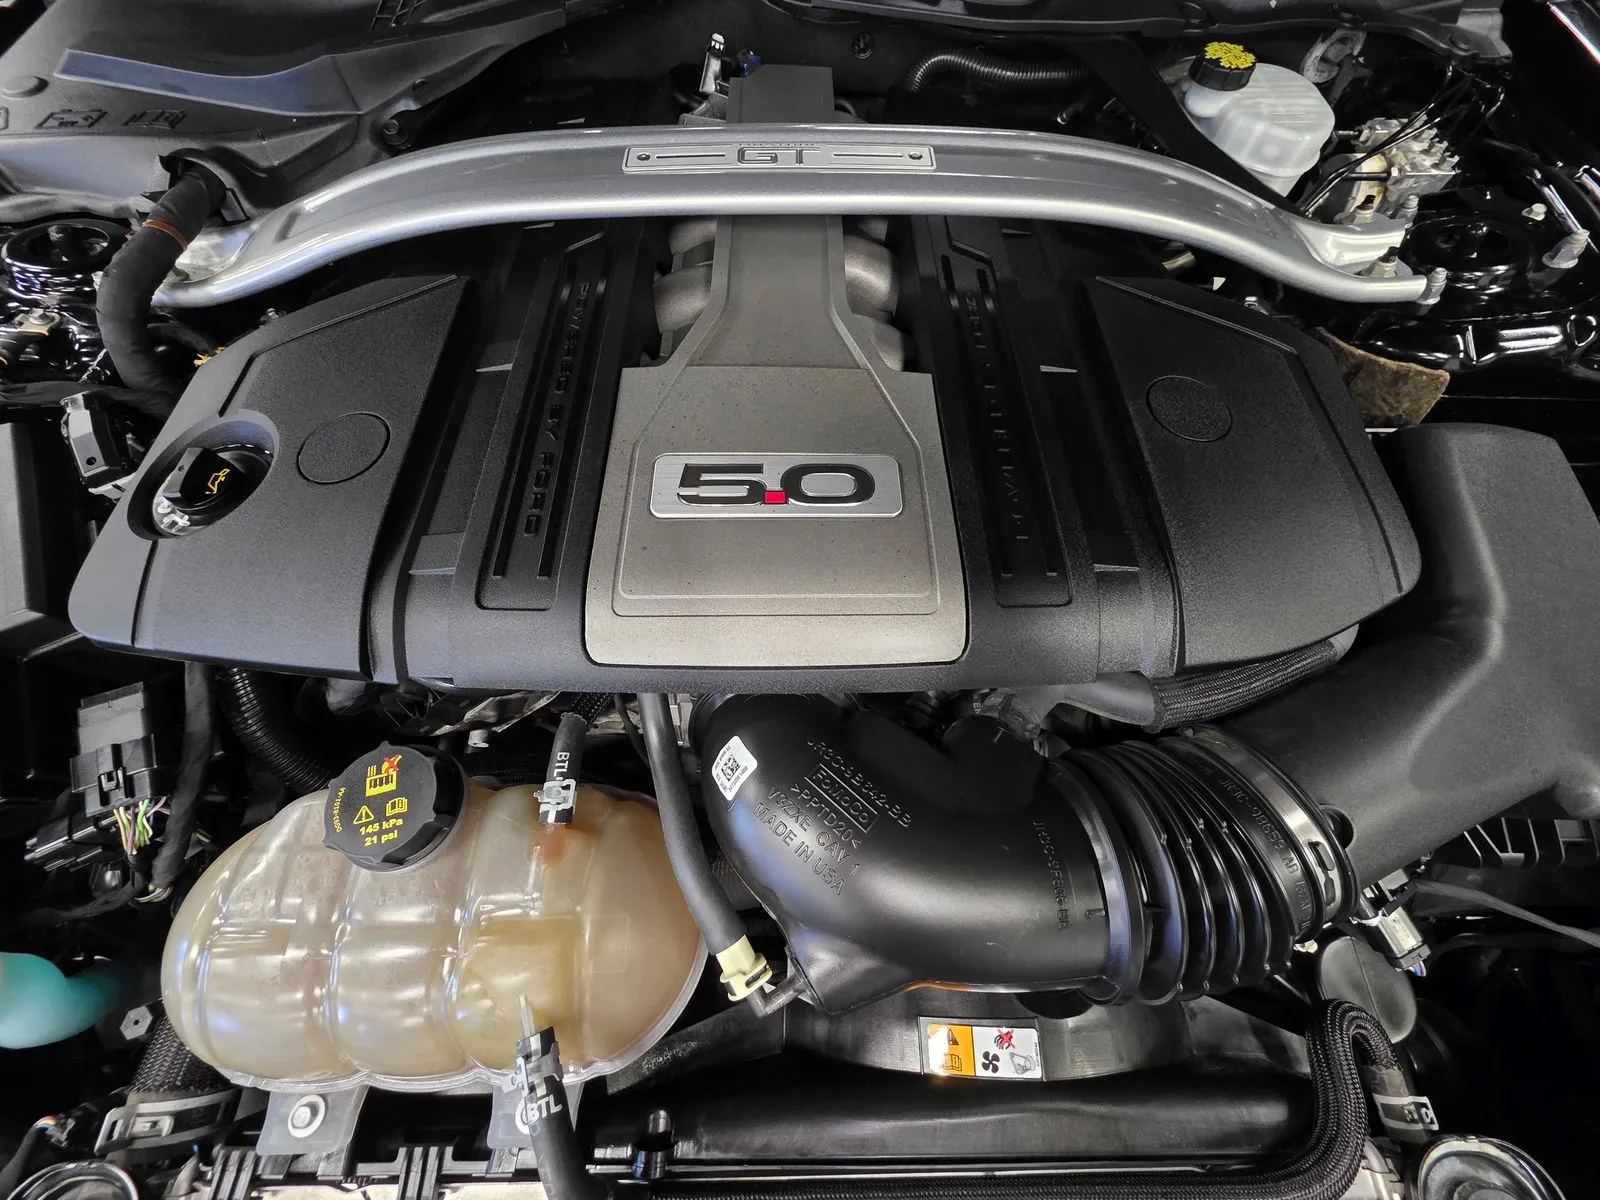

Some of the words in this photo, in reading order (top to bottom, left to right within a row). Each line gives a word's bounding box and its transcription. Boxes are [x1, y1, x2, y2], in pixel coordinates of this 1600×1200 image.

[737, 146, 821, 165] GT
[554, 281, 590, 394] POWERED
[546, 404, 565, 441] BY
[523, 452, 554, 537] FORD
[676, 463, 876, 506] 5.0
[812, 769, 869, 823] FoMoCo
[359, 822, 380, 836] 145
[382, 818, 404, 830] kPa
[364, 834, 378, 847] 21
[381, 830, 398, 844] psi
[753, 801, 797, 847] MADE
[794, 841, 815, 863] IN
[813, 857, 845, 896] USA
[815, 831, 850, 864] CAV
[850, 863, 861, 877] 1
[527, 1095, 563, 1126] BTL
